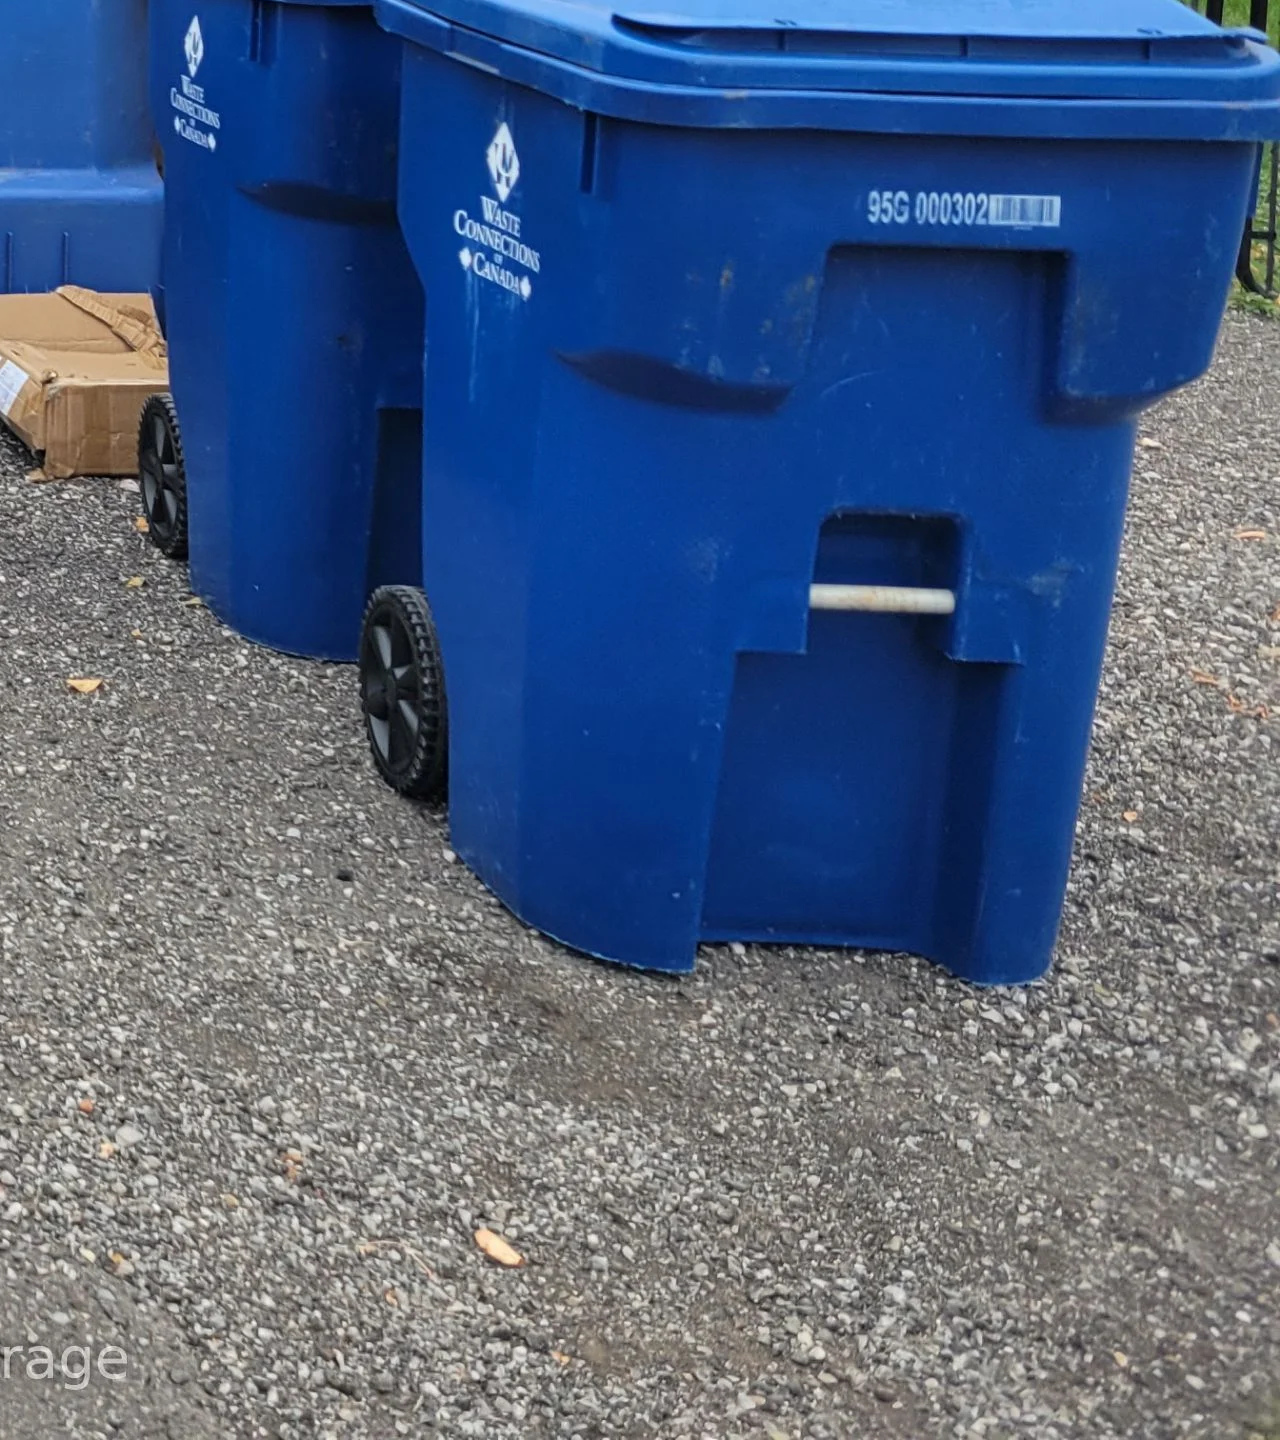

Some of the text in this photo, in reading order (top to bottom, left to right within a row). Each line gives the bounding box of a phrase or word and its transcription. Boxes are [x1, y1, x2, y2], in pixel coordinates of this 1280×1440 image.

[480, 195, 521, 239] WASTE
[867, 190, 989, 226] 95G 000302
[453, 210, 540, 274] CONNECTIONS
[472, 252, 520, 296] CANADA
